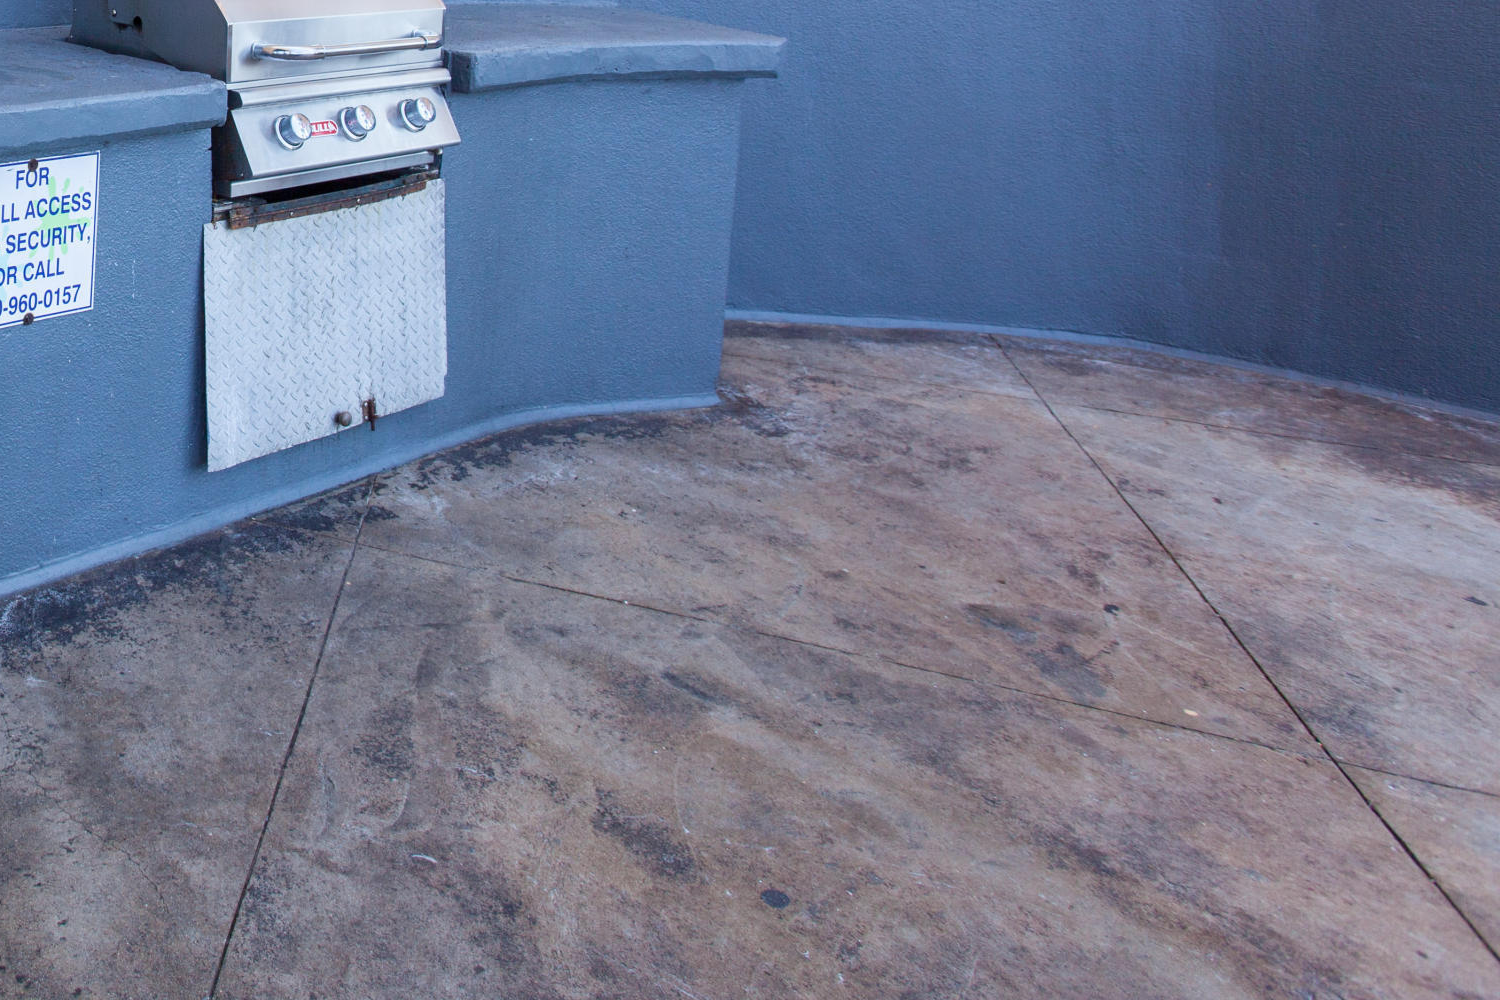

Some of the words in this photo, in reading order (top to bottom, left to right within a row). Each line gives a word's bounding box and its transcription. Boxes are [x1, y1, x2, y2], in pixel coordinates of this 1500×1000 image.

[15, 166, 50, 190] FOR
[24, 191, 92, 220] ACCESS
[5, 222, 91, 254] SECURITY,
[22, 257, 65, 282] CALL
